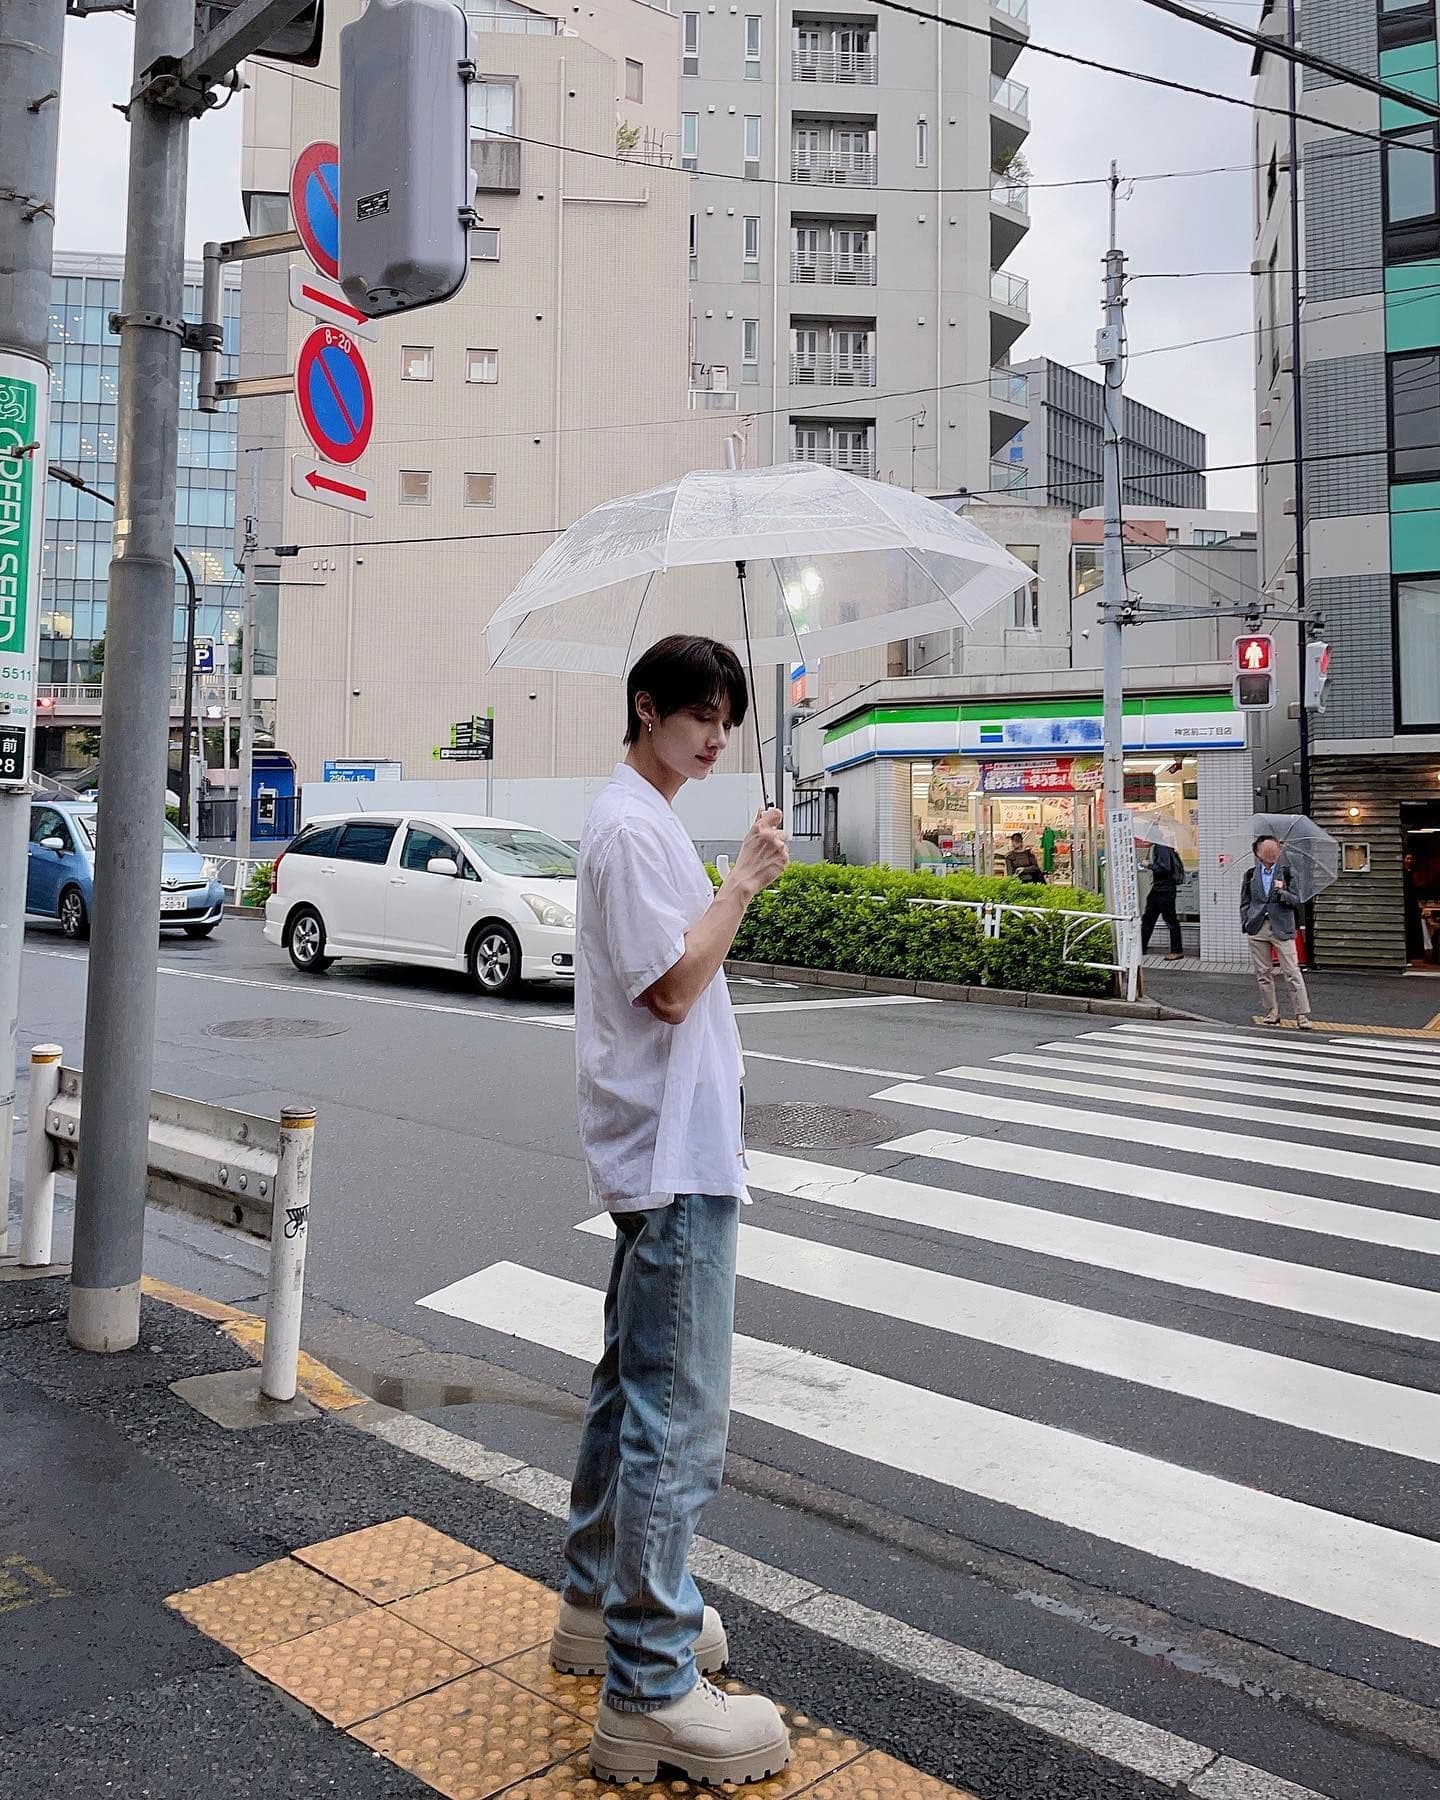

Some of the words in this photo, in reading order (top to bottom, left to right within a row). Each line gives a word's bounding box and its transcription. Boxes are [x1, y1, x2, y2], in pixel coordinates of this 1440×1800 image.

[325, 329, 351, 353] 8-20
[195, 649, 209, 665] P
[2, 737, 18, 753] 前
